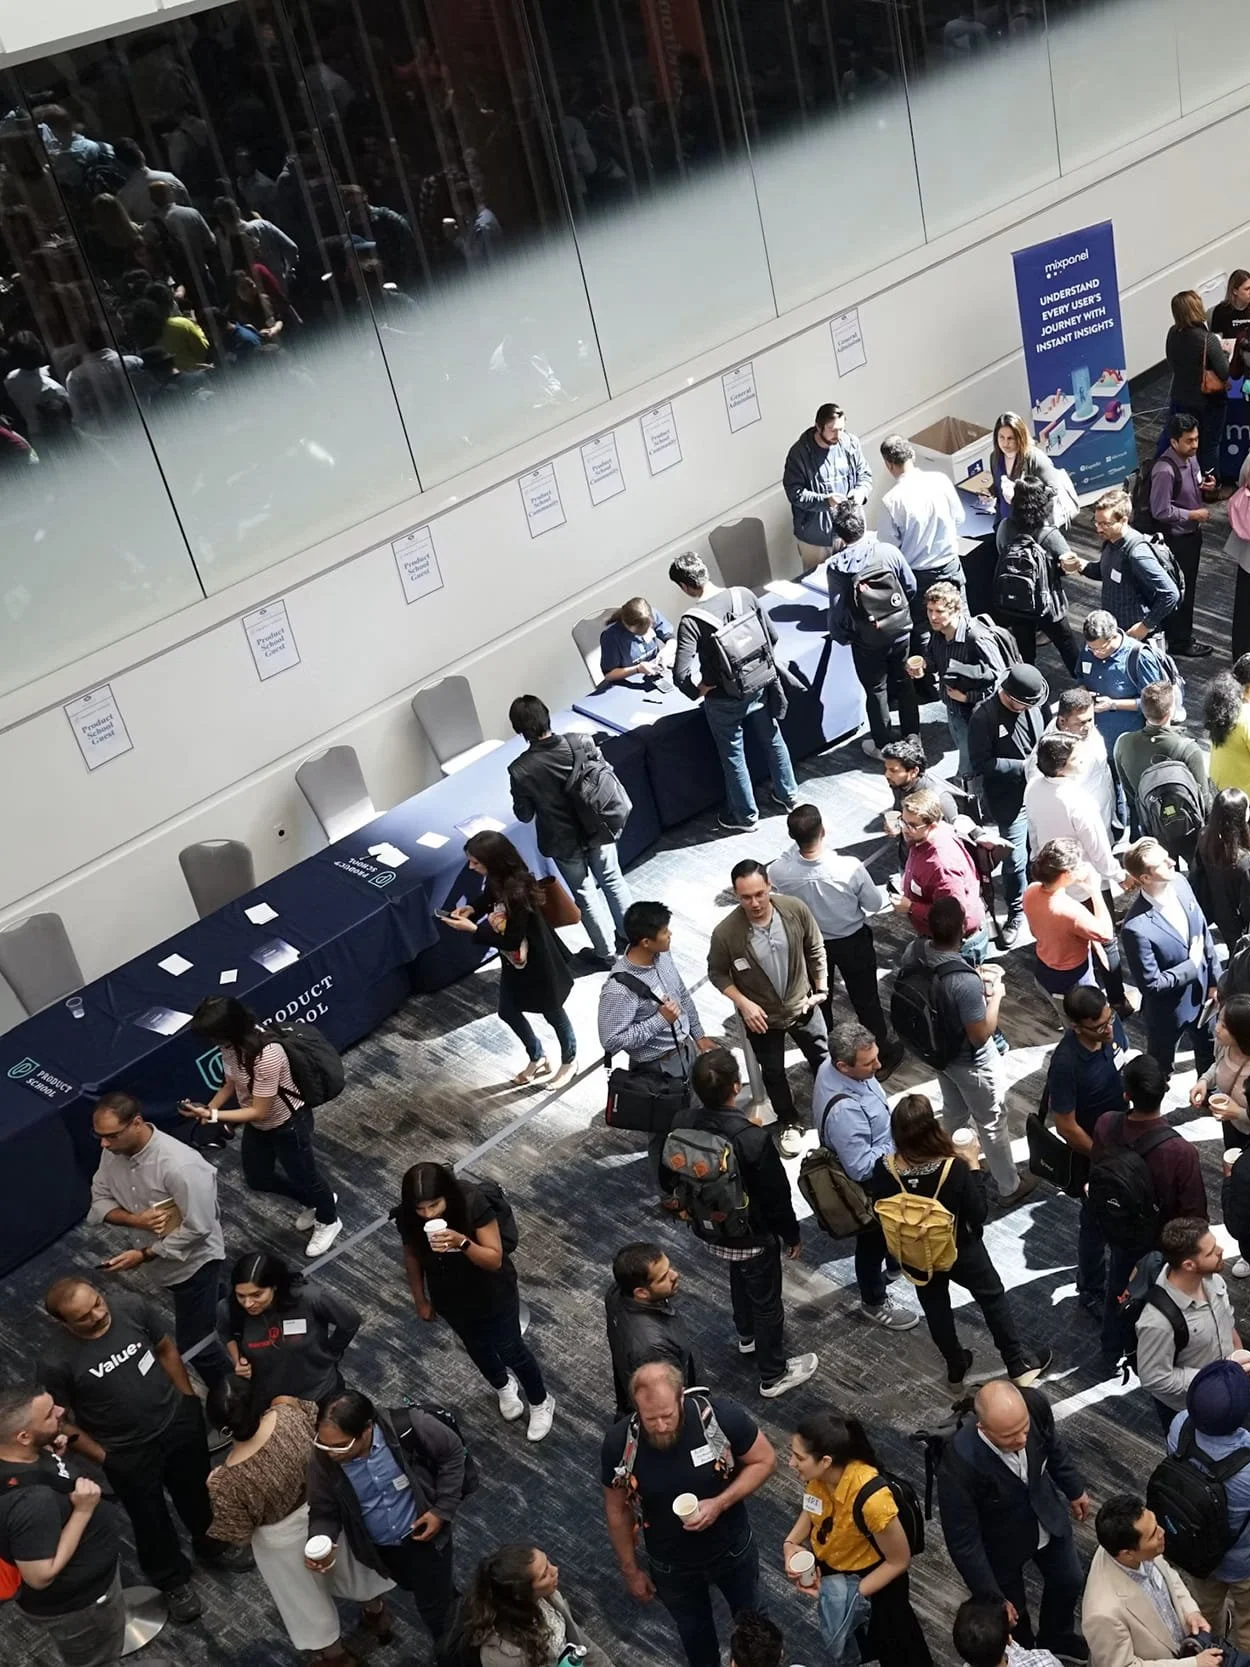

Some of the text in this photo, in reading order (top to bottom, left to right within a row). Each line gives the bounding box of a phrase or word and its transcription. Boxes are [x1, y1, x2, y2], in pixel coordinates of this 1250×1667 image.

[1045, 248, 1089, 273] mixpanel
[1040, 278, 1100, 306] UNDERSTAND
[1042, 292, 1102, 321] EVERY USER'S
[1041, 306, 1106, 337] JOURNEY WITH
[1036, 318, 1114, 353] INSTANT INSIGHTS
[730, 386, 752, 401] General
[404, 553, 430, 570] Product
[408, 560, 430, 574] School
[411, 567, 431, 582] Guest
[257, 627, 285, 645] Product
[261, 635, 285, 650] School
[265, 642, 286, 657] Guest
[82, 713, 113, 733] Product
[87, 721, 114, 738] School
[92, 729, 115, 744] Guest
[334, 861, 370, 878] PRODUCT
[26, 1078, 57, 1098] SCHOOL
[36, 1070, 73, 1094] PRODUCT
